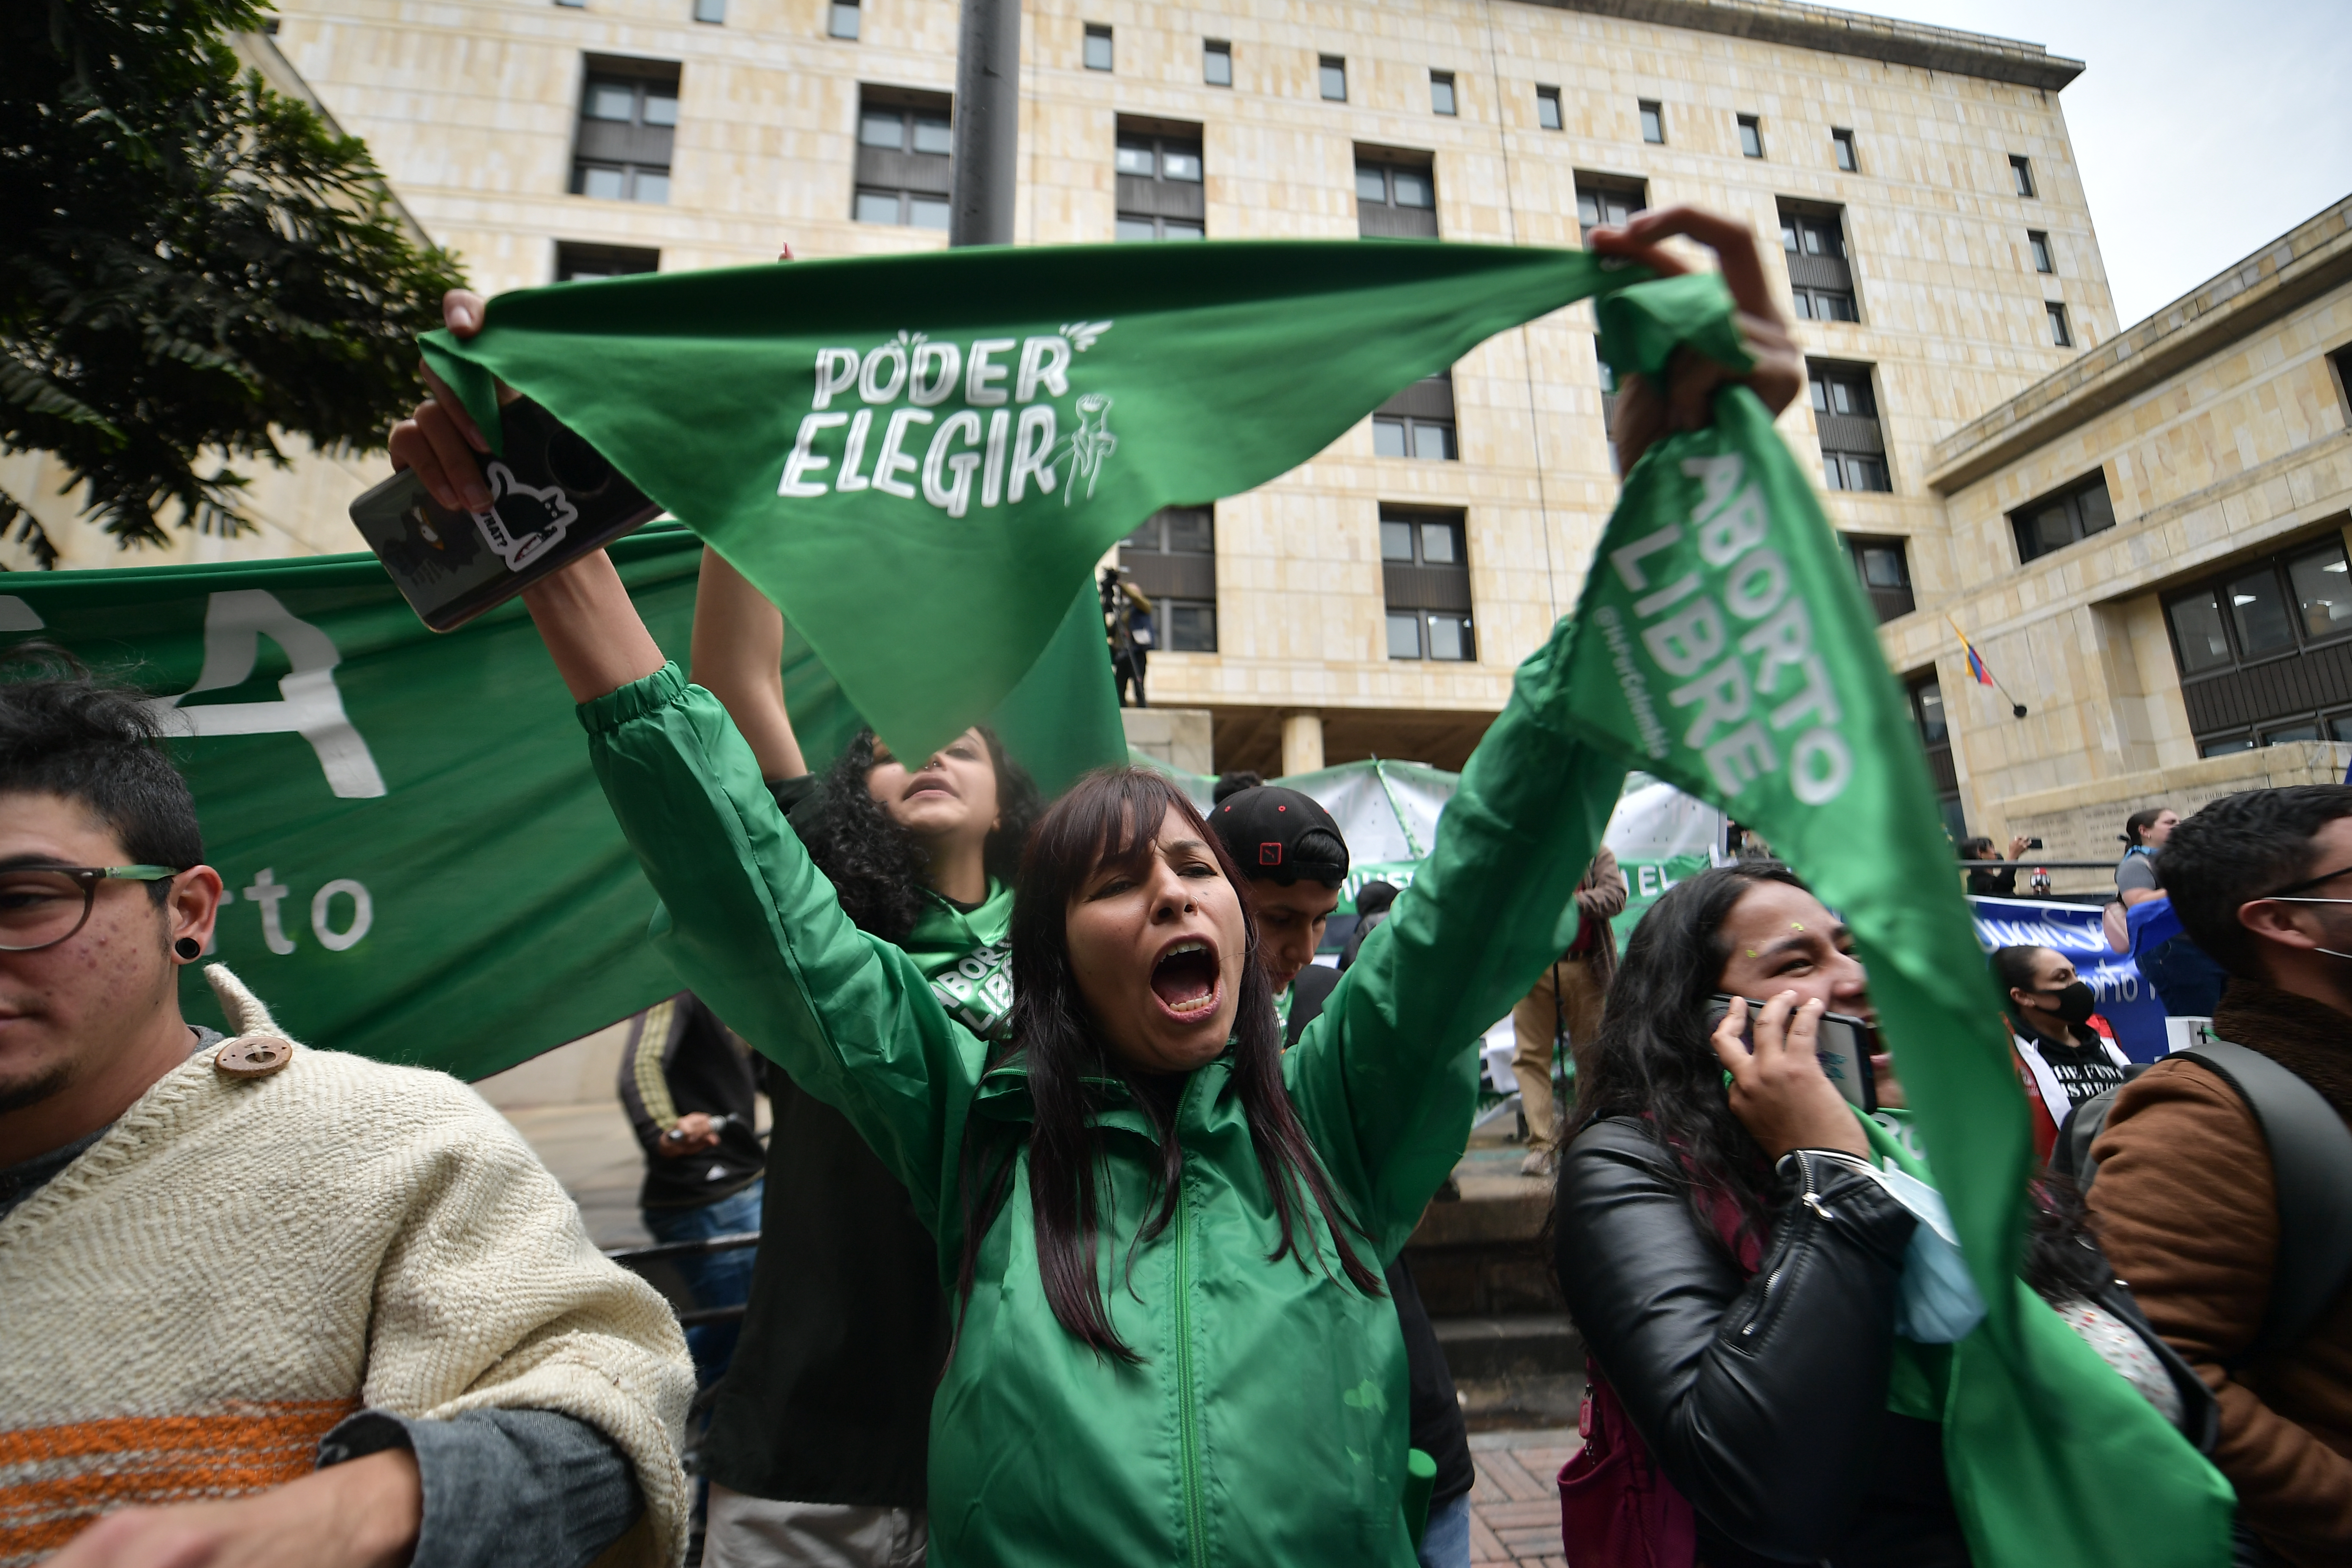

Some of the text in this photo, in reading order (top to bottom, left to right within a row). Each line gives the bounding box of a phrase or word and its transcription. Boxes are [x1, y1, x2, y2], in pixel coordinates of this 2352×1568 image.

[777, 404, 1057, 518] ELEGIR
[811, 336, 1071, 411] PODER
[1610, 523, 1779, 798] LIBRE
[1680, 452, 1853, 806] ABORTO
